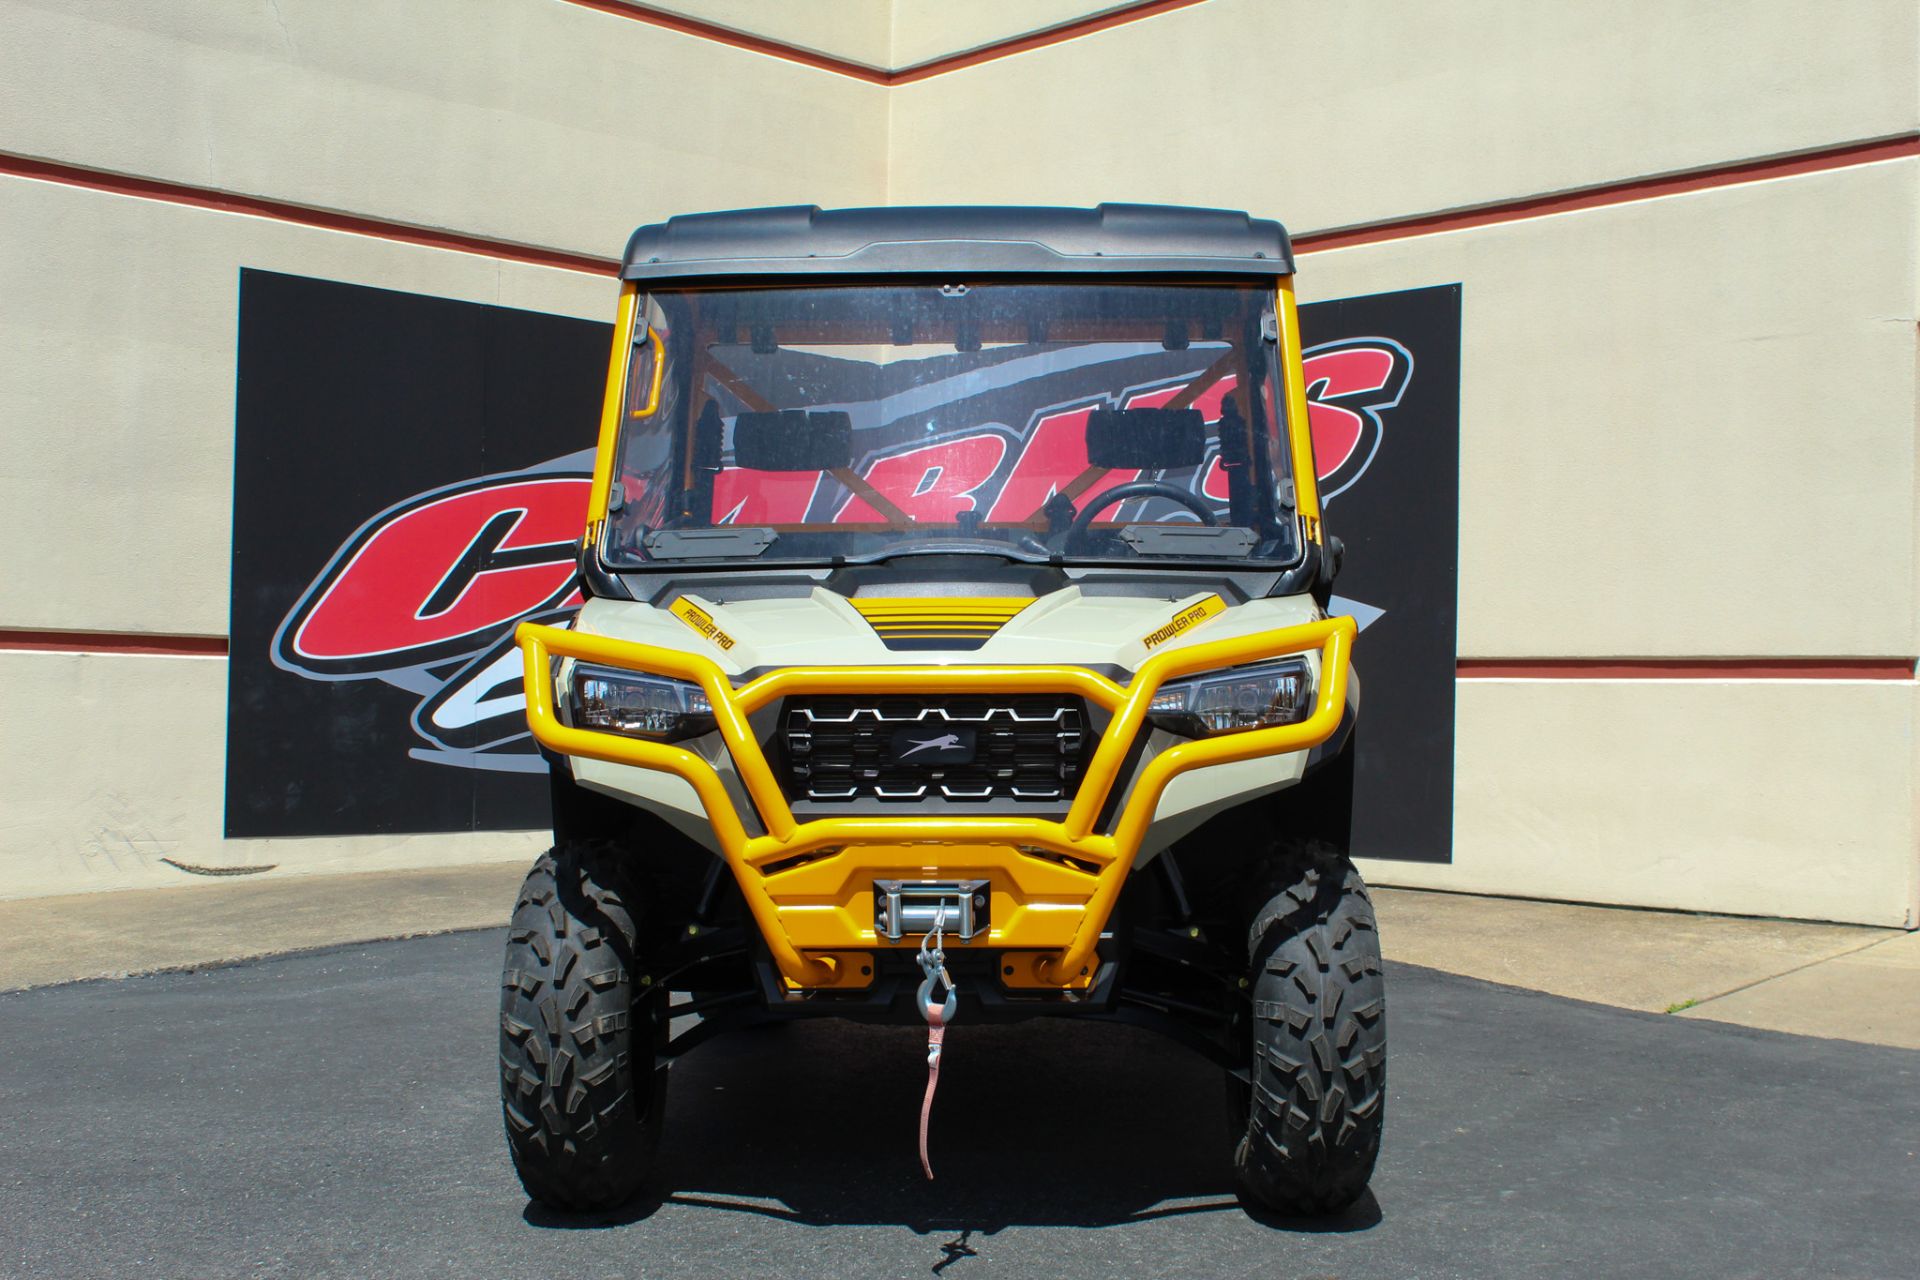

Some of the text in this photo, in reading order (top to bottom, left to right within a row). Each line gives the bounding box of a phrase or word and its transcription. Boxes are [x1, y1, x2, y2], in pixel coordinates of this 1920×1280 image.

[683, 608, 735, 650] PROWLER PRO
[1143, 606, 1207, 650] PROWLER PRO
